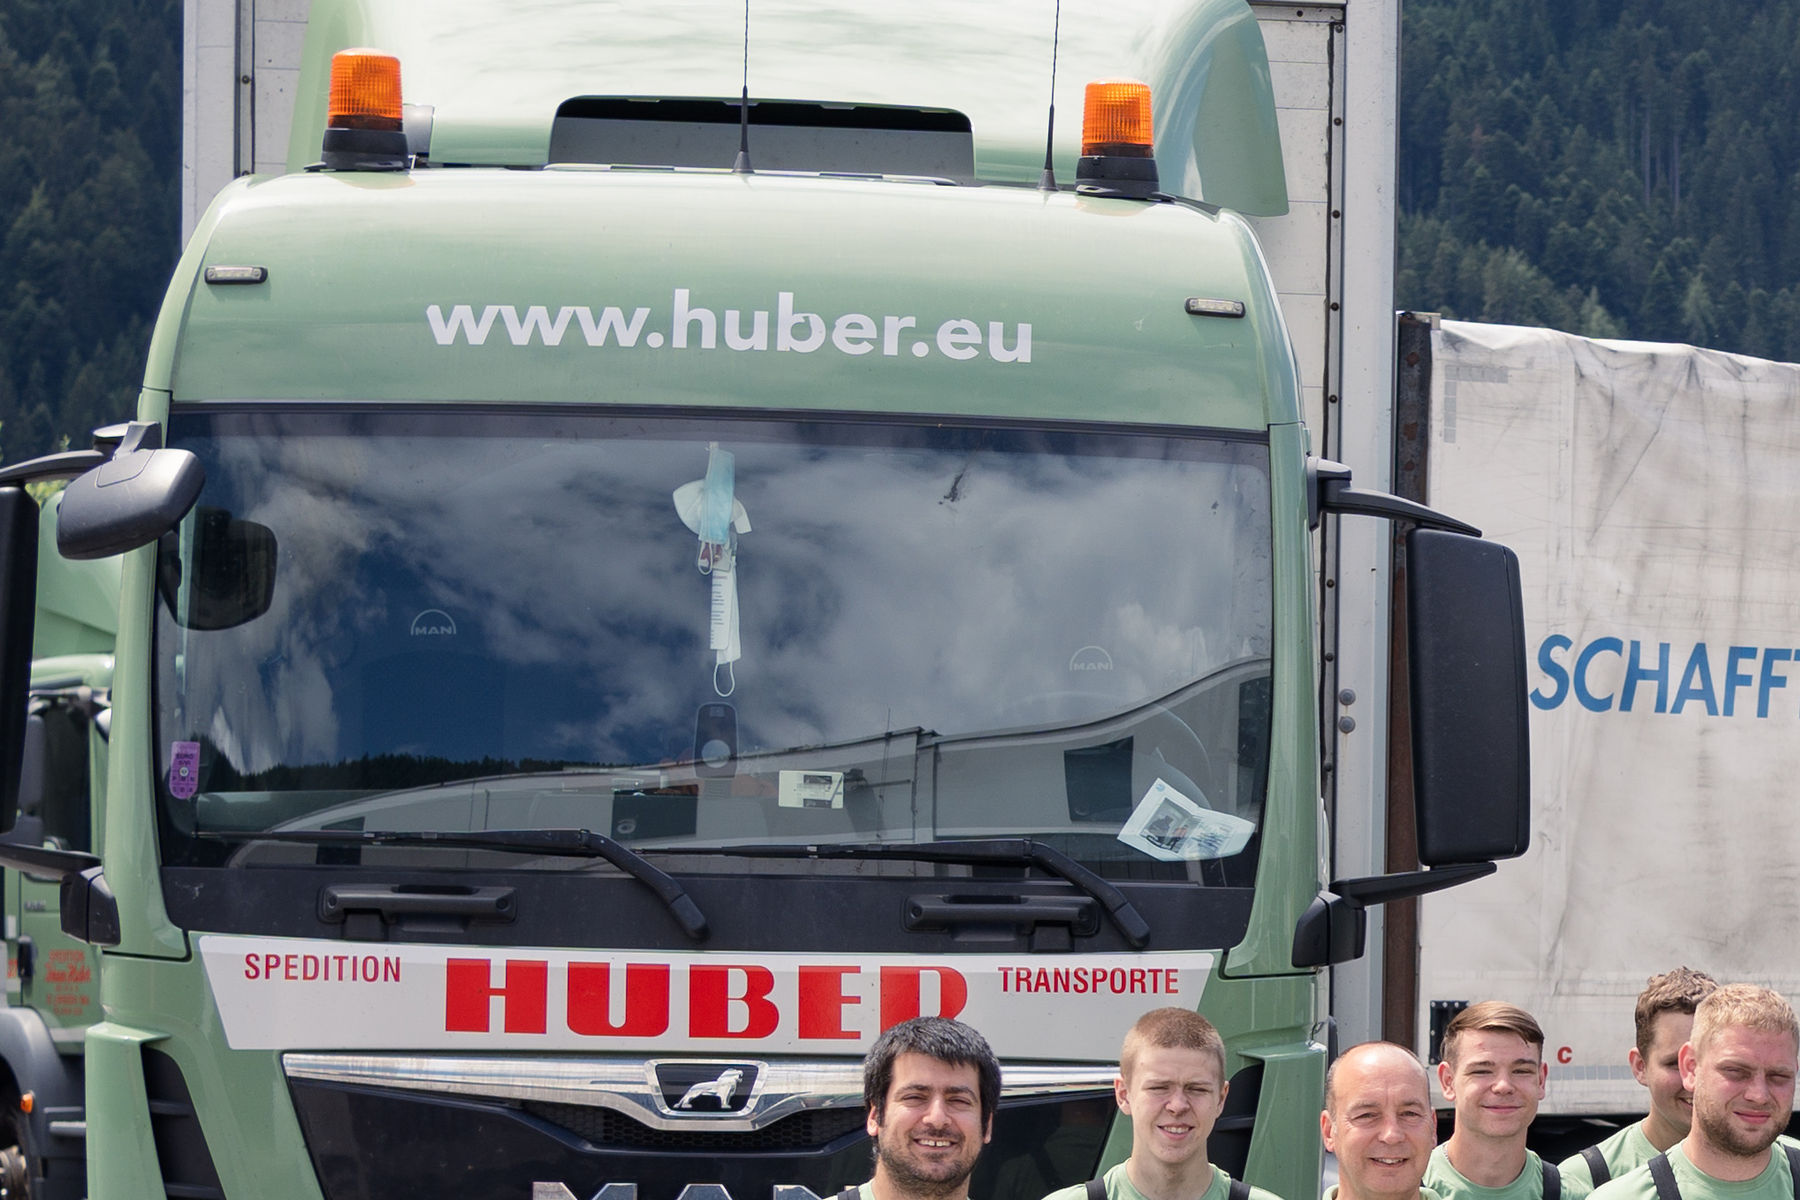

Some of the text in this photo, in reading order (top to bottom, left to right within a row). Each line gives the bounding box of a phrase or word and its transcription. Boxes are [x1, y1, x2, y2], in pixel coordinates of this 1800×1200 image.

[426, 288, 1032, 363] www.huber.eu
[243, 953, 1179, 1040] SPEDITION HUBER TRANSPORTE
[1557, 1046, 1573, 1064] C
